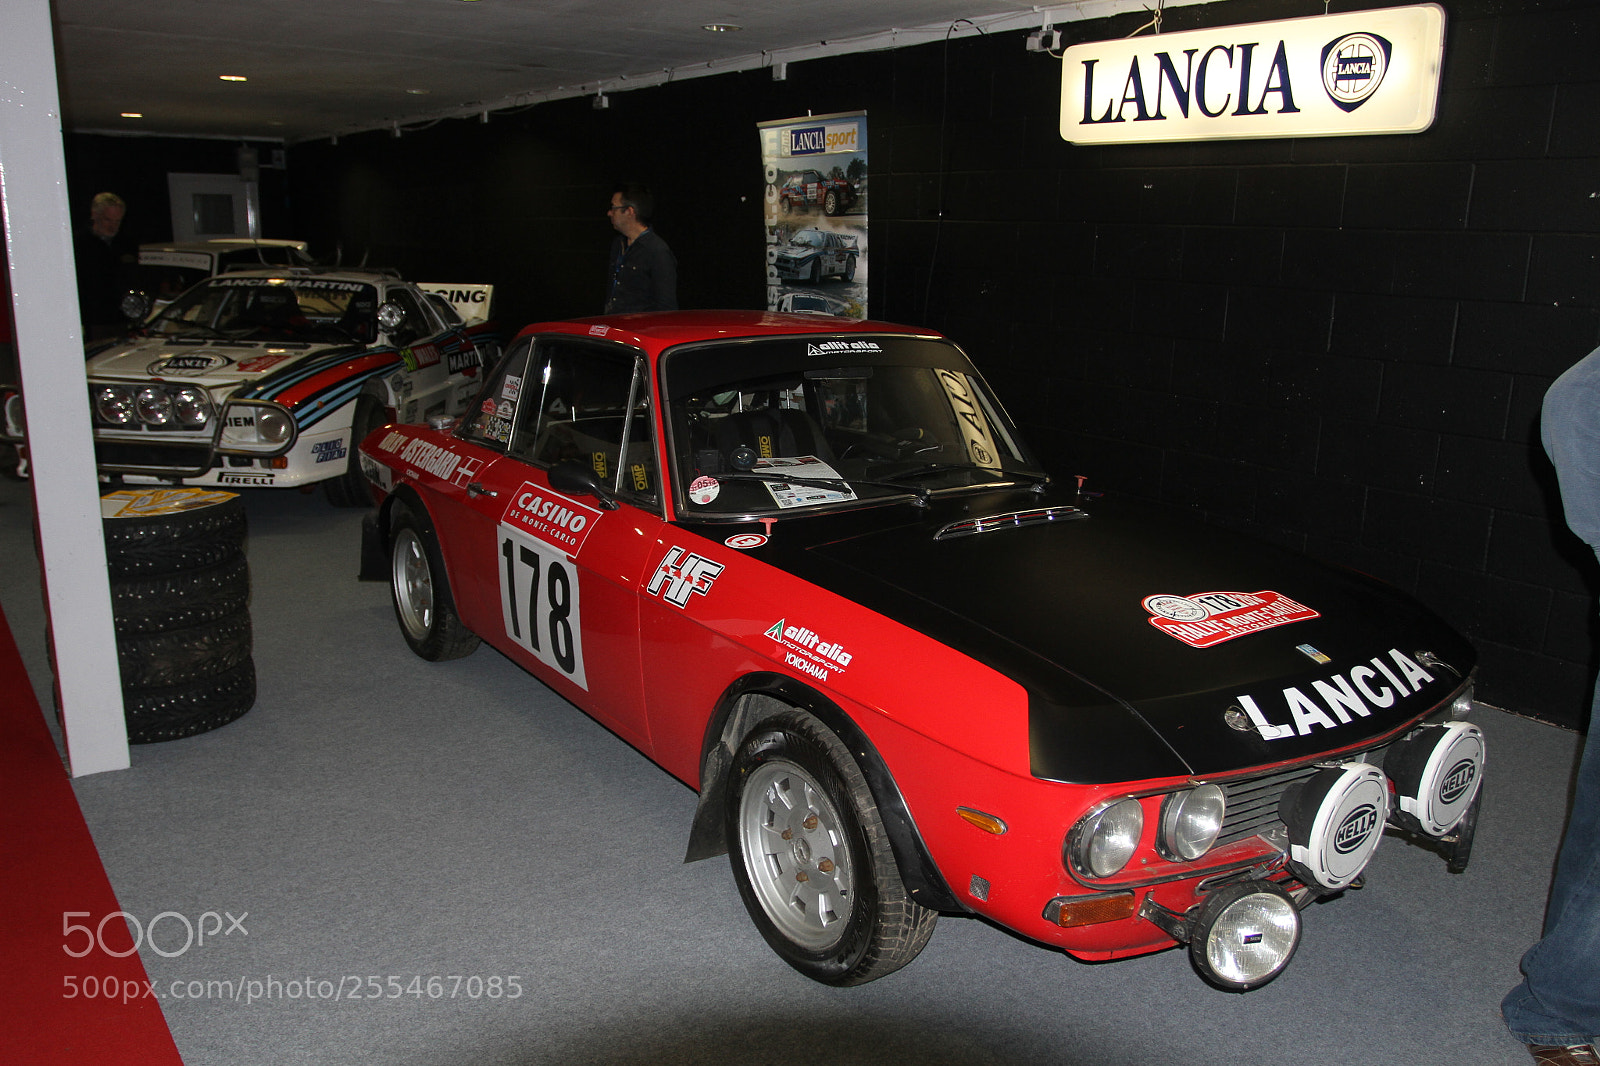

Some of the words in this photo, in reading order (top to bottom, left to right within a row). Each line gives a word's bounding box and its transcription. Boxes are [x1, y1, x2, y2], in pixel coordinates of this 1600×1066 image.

[1338, 61, 1371, 76] LANCIA
[1079, 40, 1300, 125] LANCIA
[791, 131, 825, 152] LANCIA
[826, 127, 857, 150] sport
[284, 279, 364, 292] MARTINI
[317, 448, 346, 463] FIAT
[594, 452, 605, 479] OMP
[217, 471, 275, 486] PIRELLI
[632, 464, 646, 490] OMP
[517, 492, 587, 533] CASINO
[510, 509, 521, 520] DE
[521, 514, 577, 546] MONTE-CARLO
[647, 545, 725, 609] HF
[502, 538, 575, 674] 178
[1199, 594, 1242, 612] 178
[1163, 619, 1224, 642] RALLYE
[1222, 596, 1308, 630] MONTE-CARLO
[1226, 615, 1291, 636] HISTORIQUE
[780, 640, 846, 674] MOTORSPORT
[784, 625, 853, 667] allitalia
[784, 651, 829, 682] YOKOHAMA
[1237, 648, 1435, 741] LANCIA
[1441, 767, 1475, 793] HELLA
[1337, 813, 1378, 840] HELLA
